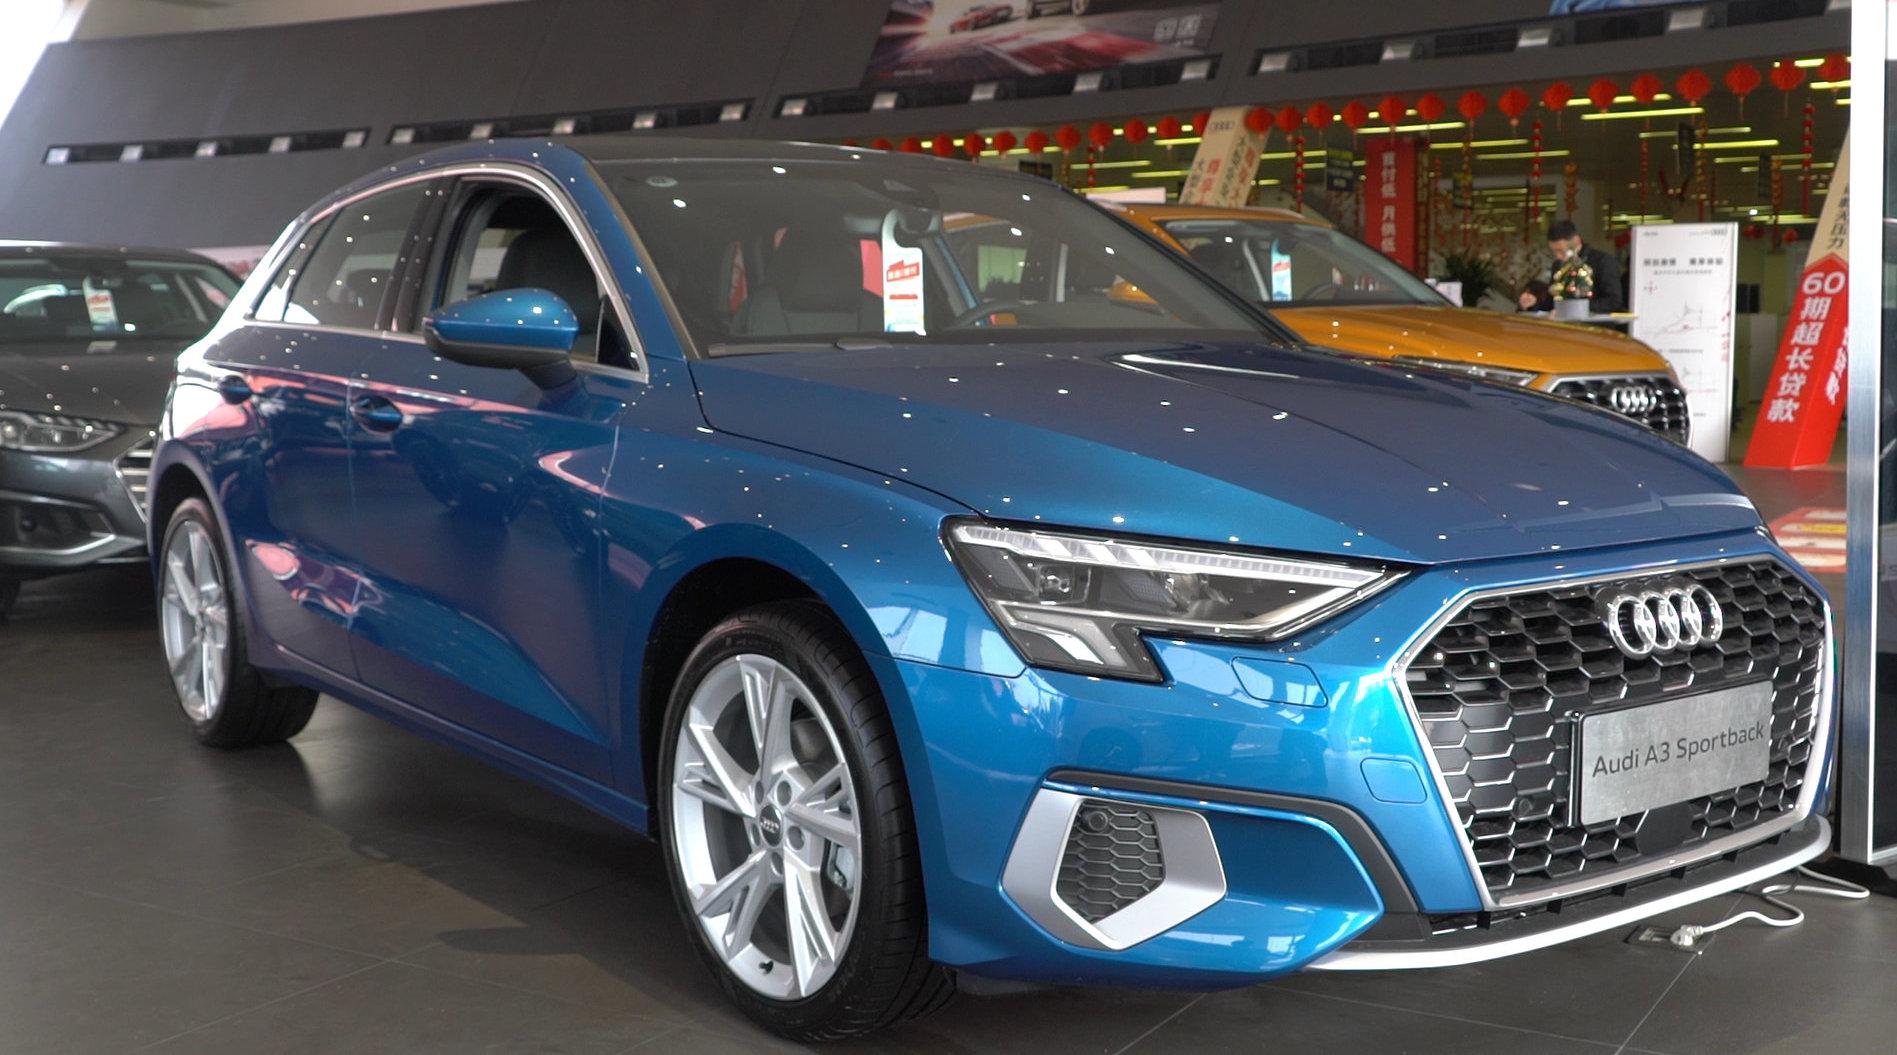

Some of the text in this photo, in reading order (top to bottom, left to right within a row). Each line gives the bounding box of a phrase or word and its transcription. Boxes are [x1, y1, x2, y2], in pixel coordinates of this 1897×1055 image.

[1593, 721, 1764, 778] Audi A3 Sportback
